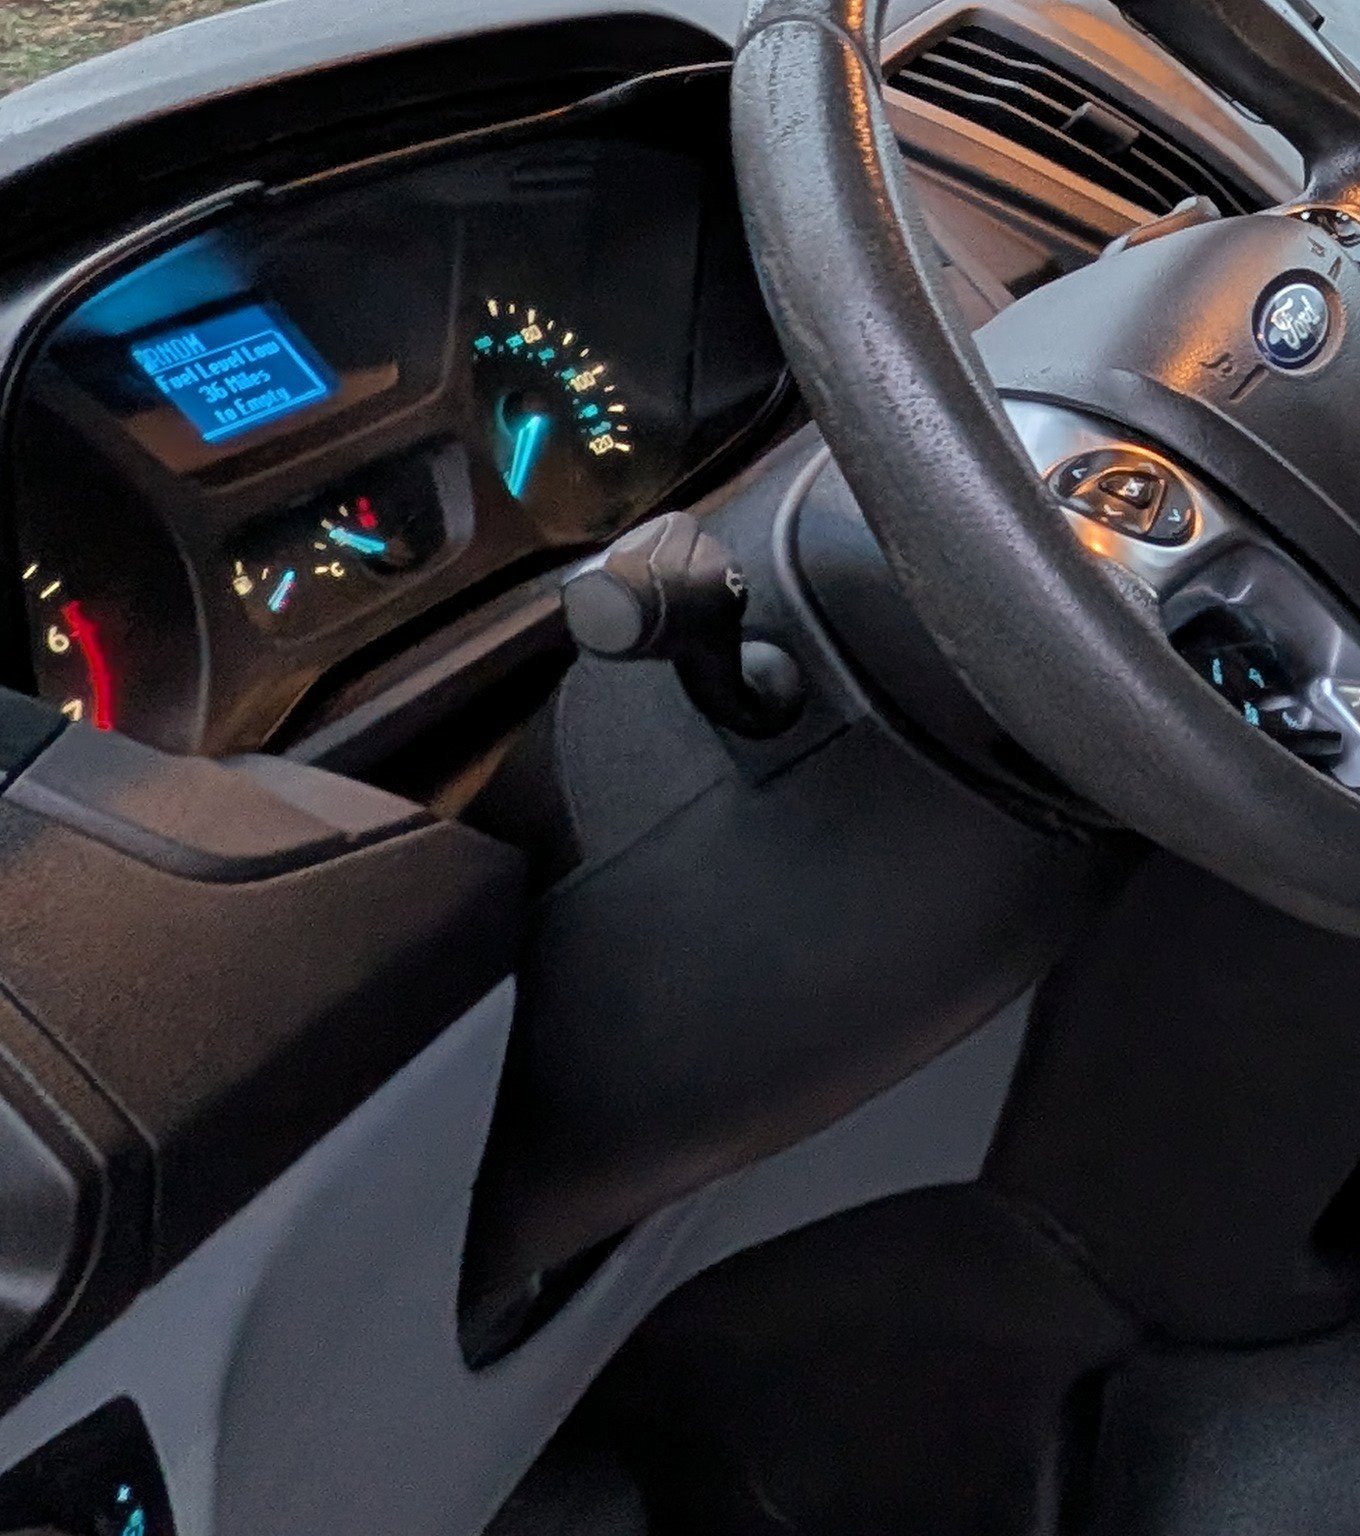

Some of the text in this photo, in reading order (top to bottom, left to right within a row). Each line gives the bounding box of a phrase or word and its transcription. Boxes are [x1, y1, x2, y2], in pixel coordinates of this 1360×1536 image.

[1268, 295, 1320, 350] Ford
[153, 340, 280, 394] Fuel Level Low
[198, 369, 272, 403] 36 Miles
[213, 386, 291, 424] to Empty
[588, 434, 614, 456] 120
[48, 625, 70, 653] 6
